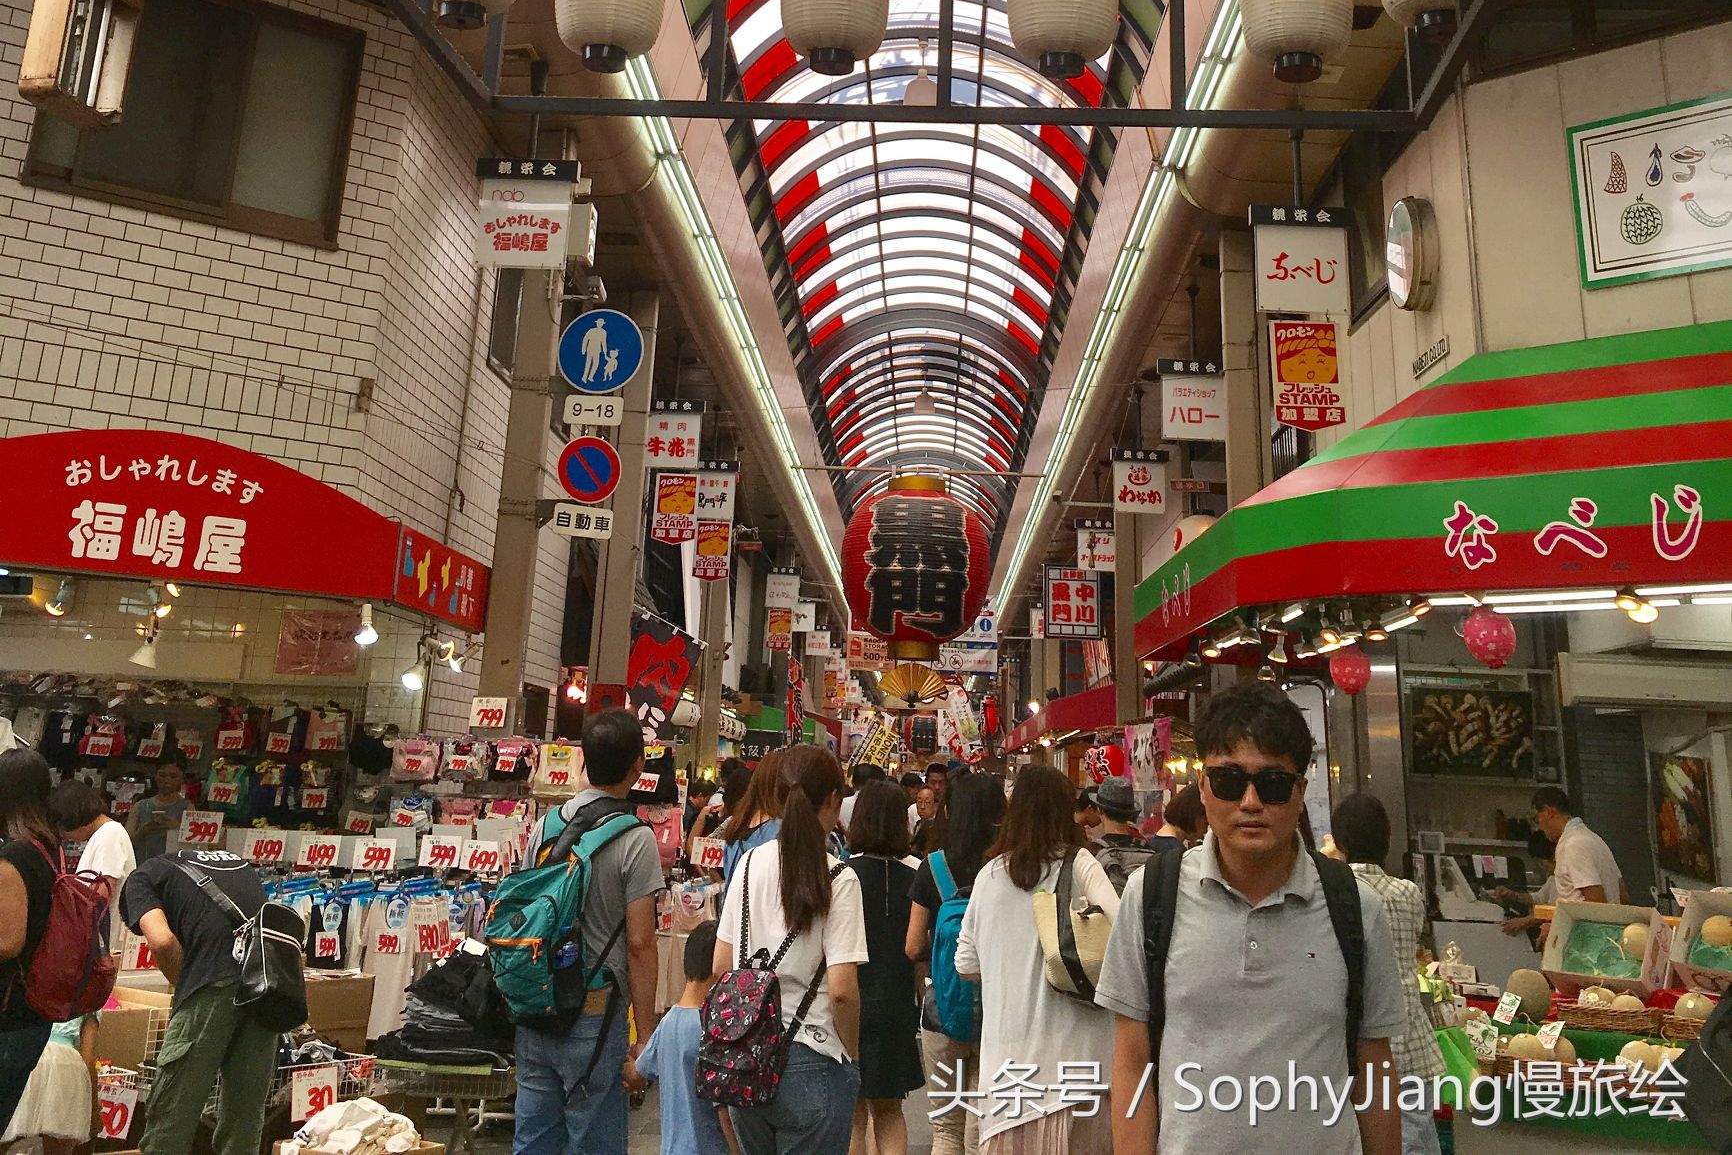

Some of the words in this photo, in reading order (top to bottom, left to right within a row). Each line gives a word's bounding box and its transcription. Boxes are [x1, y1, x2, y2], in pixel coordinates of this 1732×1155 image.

[483, 214, 562, 234] おしゃれします
[493, 232, 549, 251] 福嶋屋
[1276, 326, 1315, 340] クロモン
[1283, 383, 1332, 394] フレッシュ
[1279, 393, 1340, 406] STAMP
[1169, 406, 1220, 424] ハロー
[1280, 407, 1342, 422] 加盟店
[659, 422, 687, 432] 精肉
[65, 454, 264, 504] おしゃれします
[660, 477, 684, 487] クロモン
[1118, 484, 1162, 505] わなか
[556, 510, 611, 533] 自動車
[655, 519, 693, 528] STAMP
[1443, 484, 1703, 570] なべじ
[68, 499, 247, 574] 福嶋屋
[655, 529, 693, 538] 加盟店
[695, 560, 727, 568] STAMP
[476, 708, 504, 727] 799
[875, 731, 897, 764] MONEY
[548, 770, 569, 785] 799
[638, 778, 657, 792] 799
[184, 820, 218, 842] 399
[252, 839, 283, 860] 499
[307, 844, 336, 866] 499
[362, 846, 391, 869] 599
[428, 844, 456, 867] 599
[701, 846, 724, 866] 199
[468, 849, 498, 870] 699
[319, 937, 336, 956] 599
[378, 934, 398, 953] 599
[305, 1084, 333, 1118] 30
